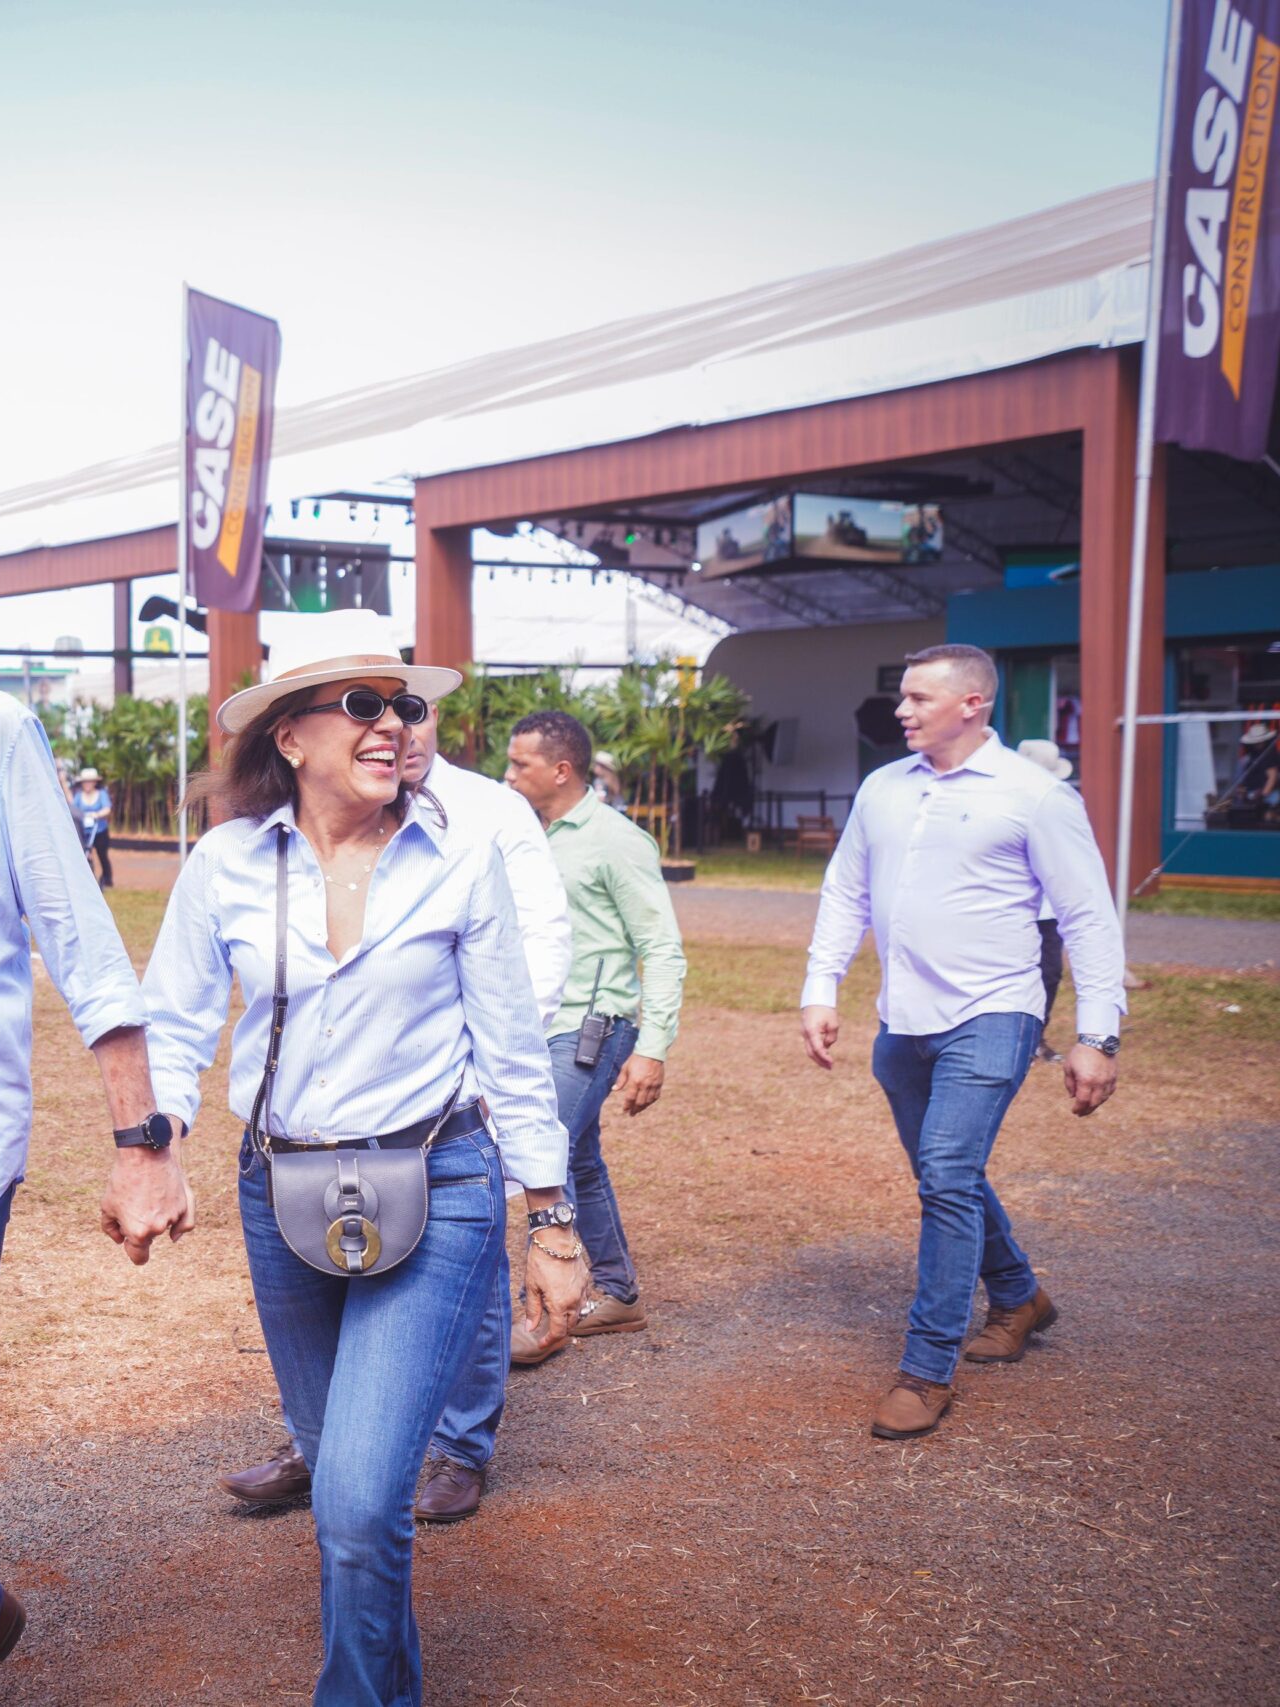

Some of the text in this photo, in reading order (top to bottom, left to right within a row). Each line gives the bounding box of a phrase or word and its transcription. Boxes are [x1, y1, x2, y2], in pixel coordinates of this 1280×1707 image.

[1183, 0, 1254, 358] CASE
[1228, 53, 1277, 333] CONSTRUCTION
[192, 337, 240, 550] CASE
